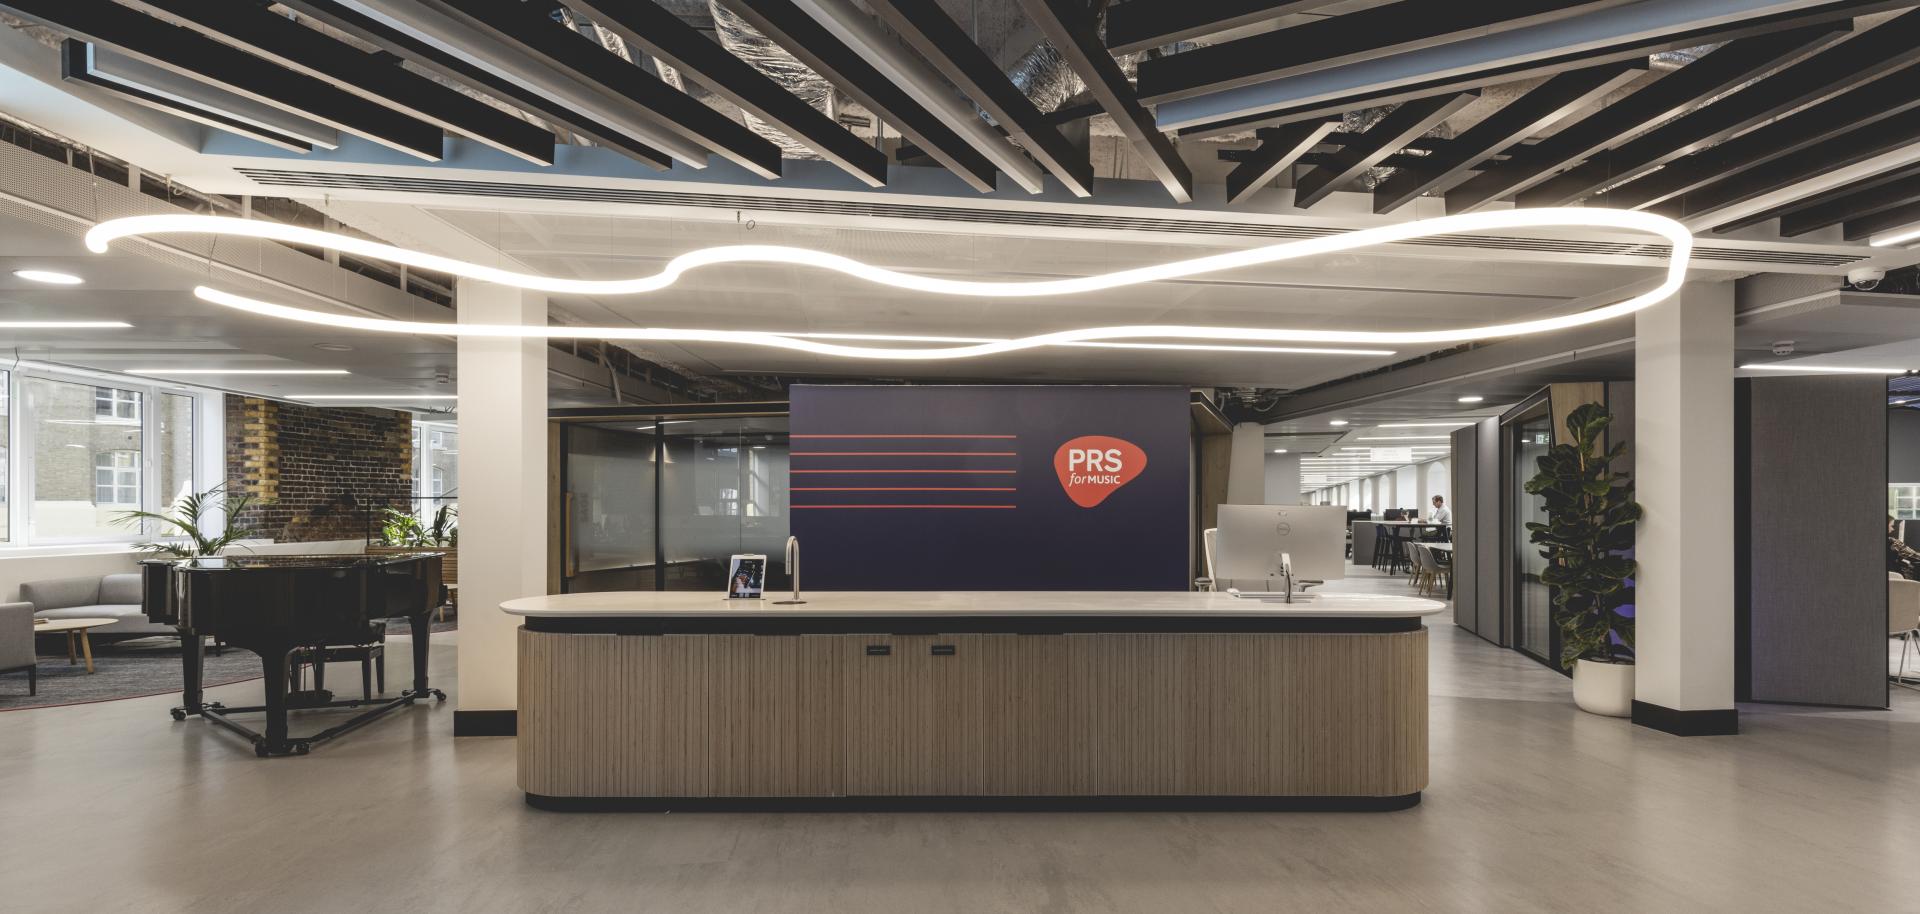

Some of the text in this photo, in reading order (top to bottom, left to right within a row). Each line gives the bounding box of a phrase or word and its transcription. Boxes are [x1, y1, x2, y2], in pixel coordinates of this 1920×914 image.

[1068, 448, 1123, 473] PRS
[1068, 472, 1121, 487] for MUSIC
